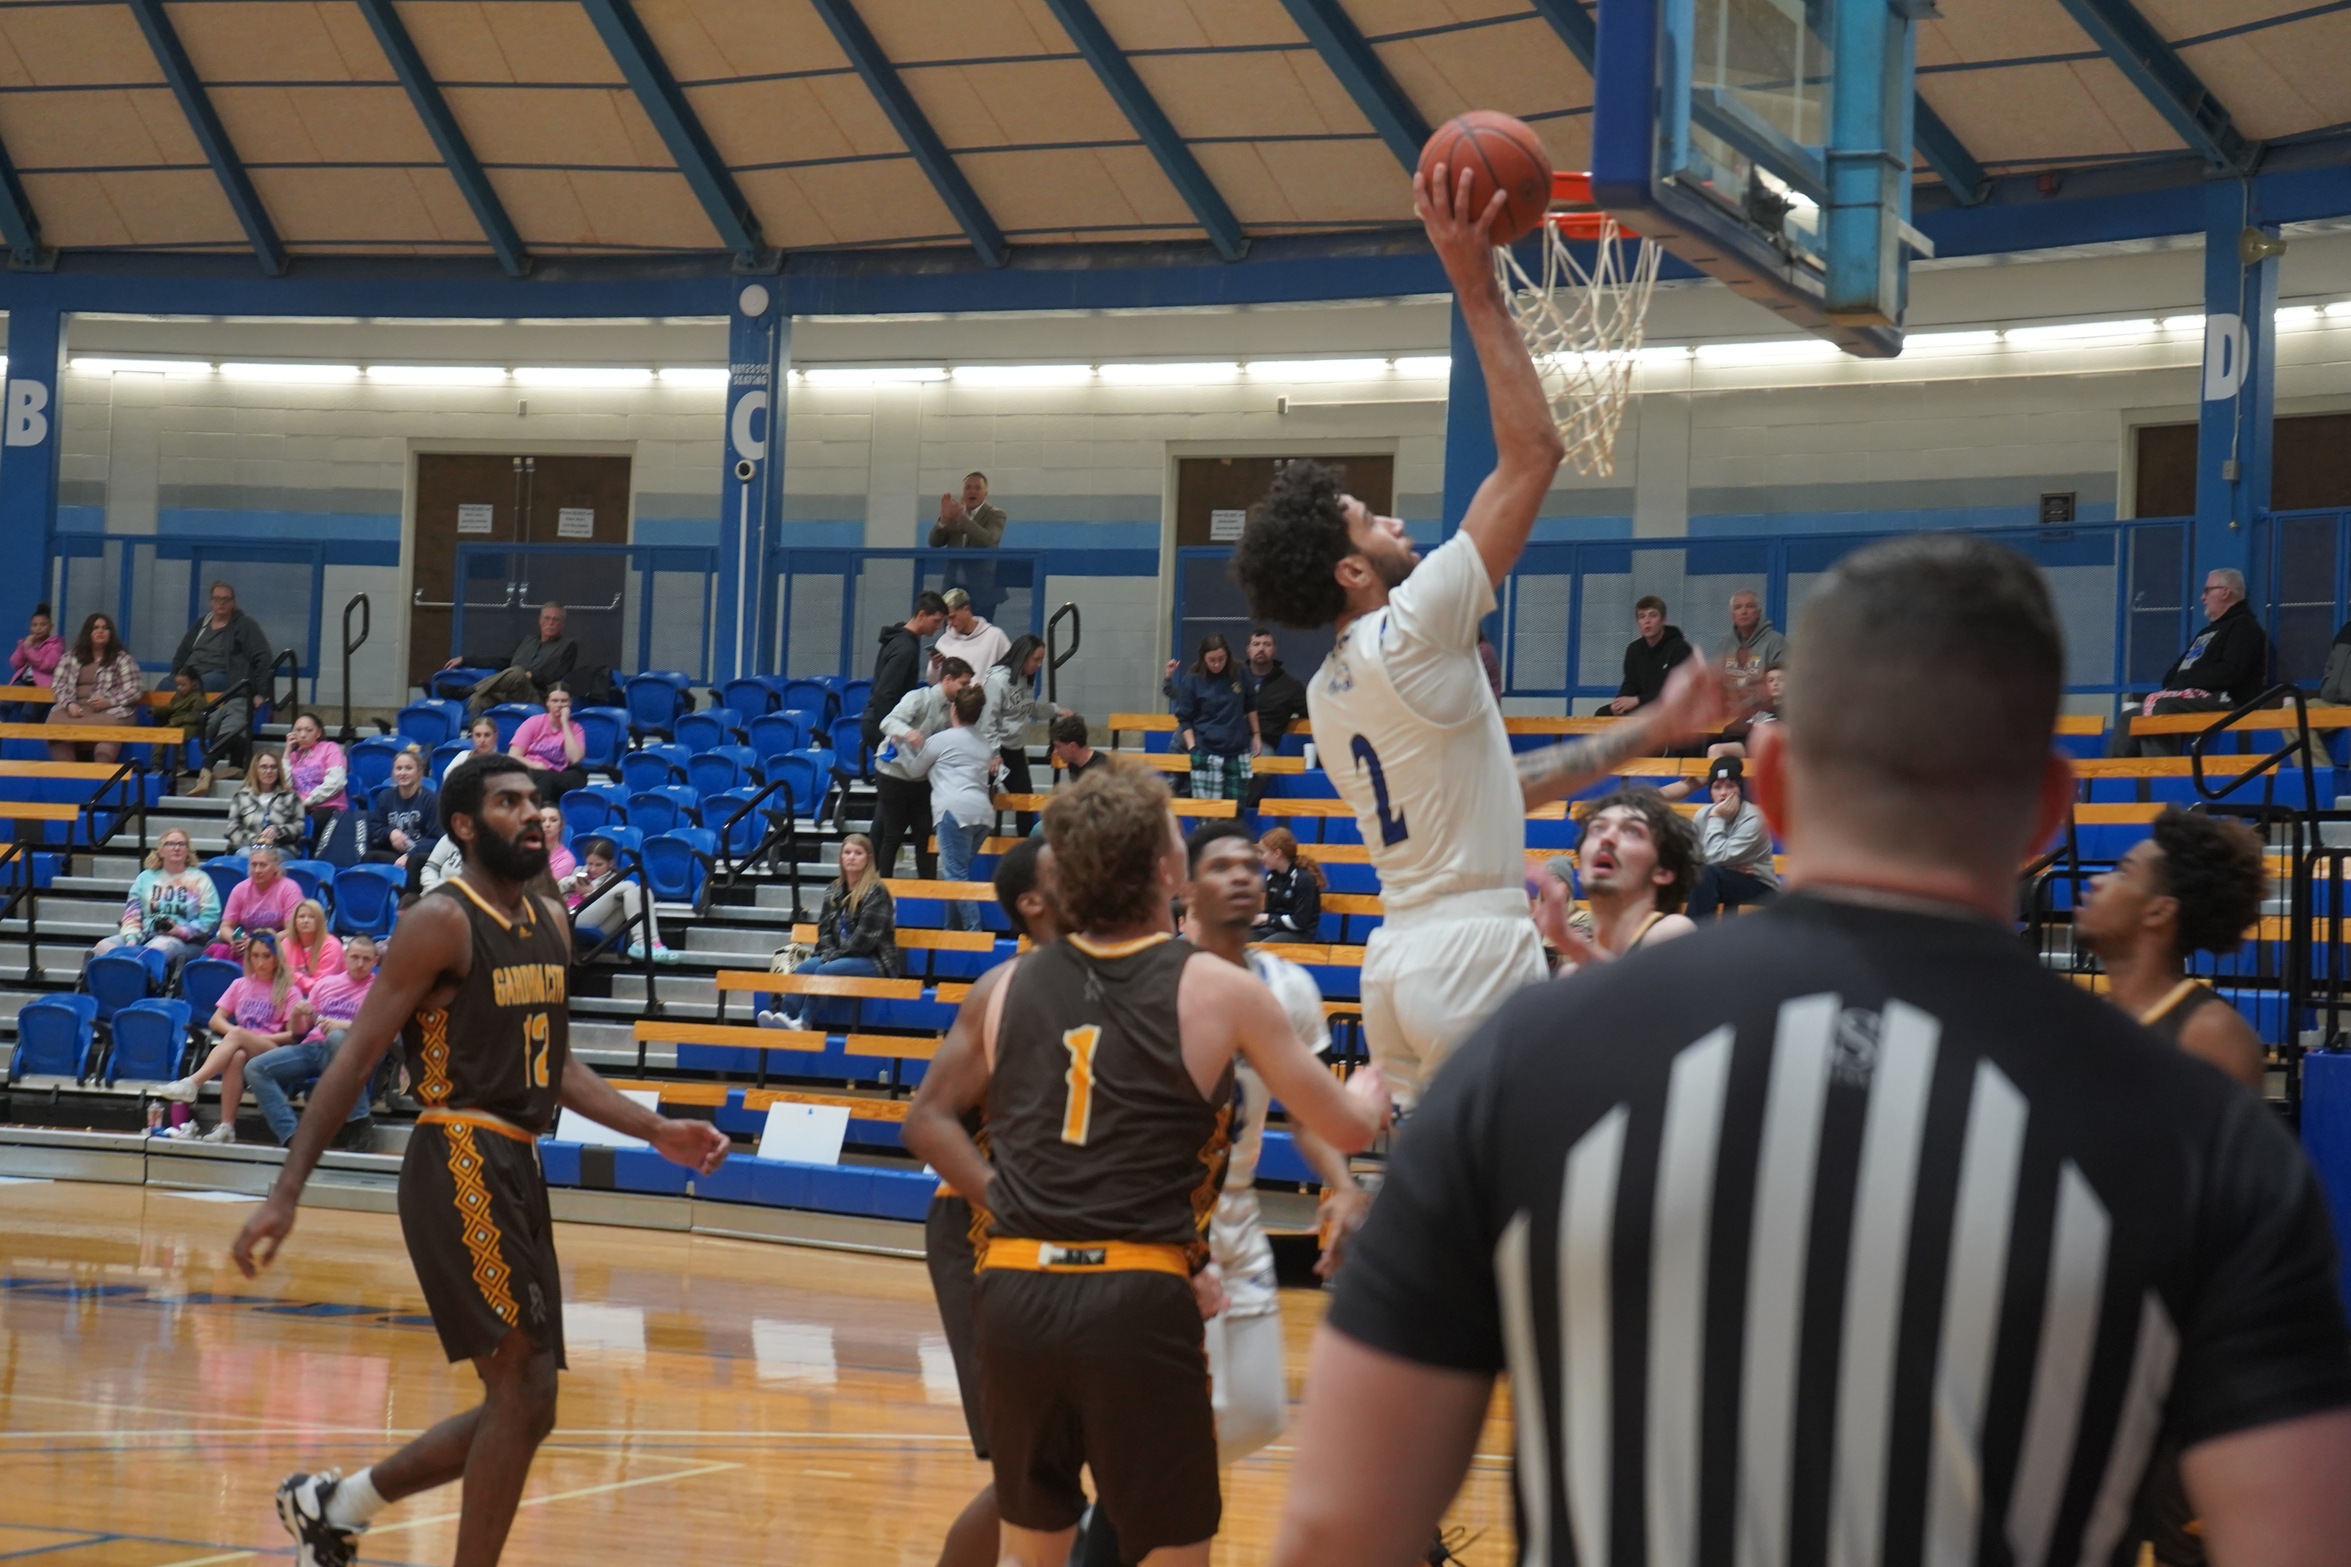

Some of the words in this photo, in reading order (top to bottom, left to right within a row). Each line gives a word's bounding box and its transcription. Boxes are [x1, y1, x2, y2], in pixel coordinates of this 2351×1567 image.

[2204, 313, 2250, 401] D
[5, 379, 48, 447] B
[731, 390, 767, 460] C
[1350, 734, 1408, 847] 2
[523, 1013, 550, 1088] 12
[1061, 1023, 1102, 1147] 1
